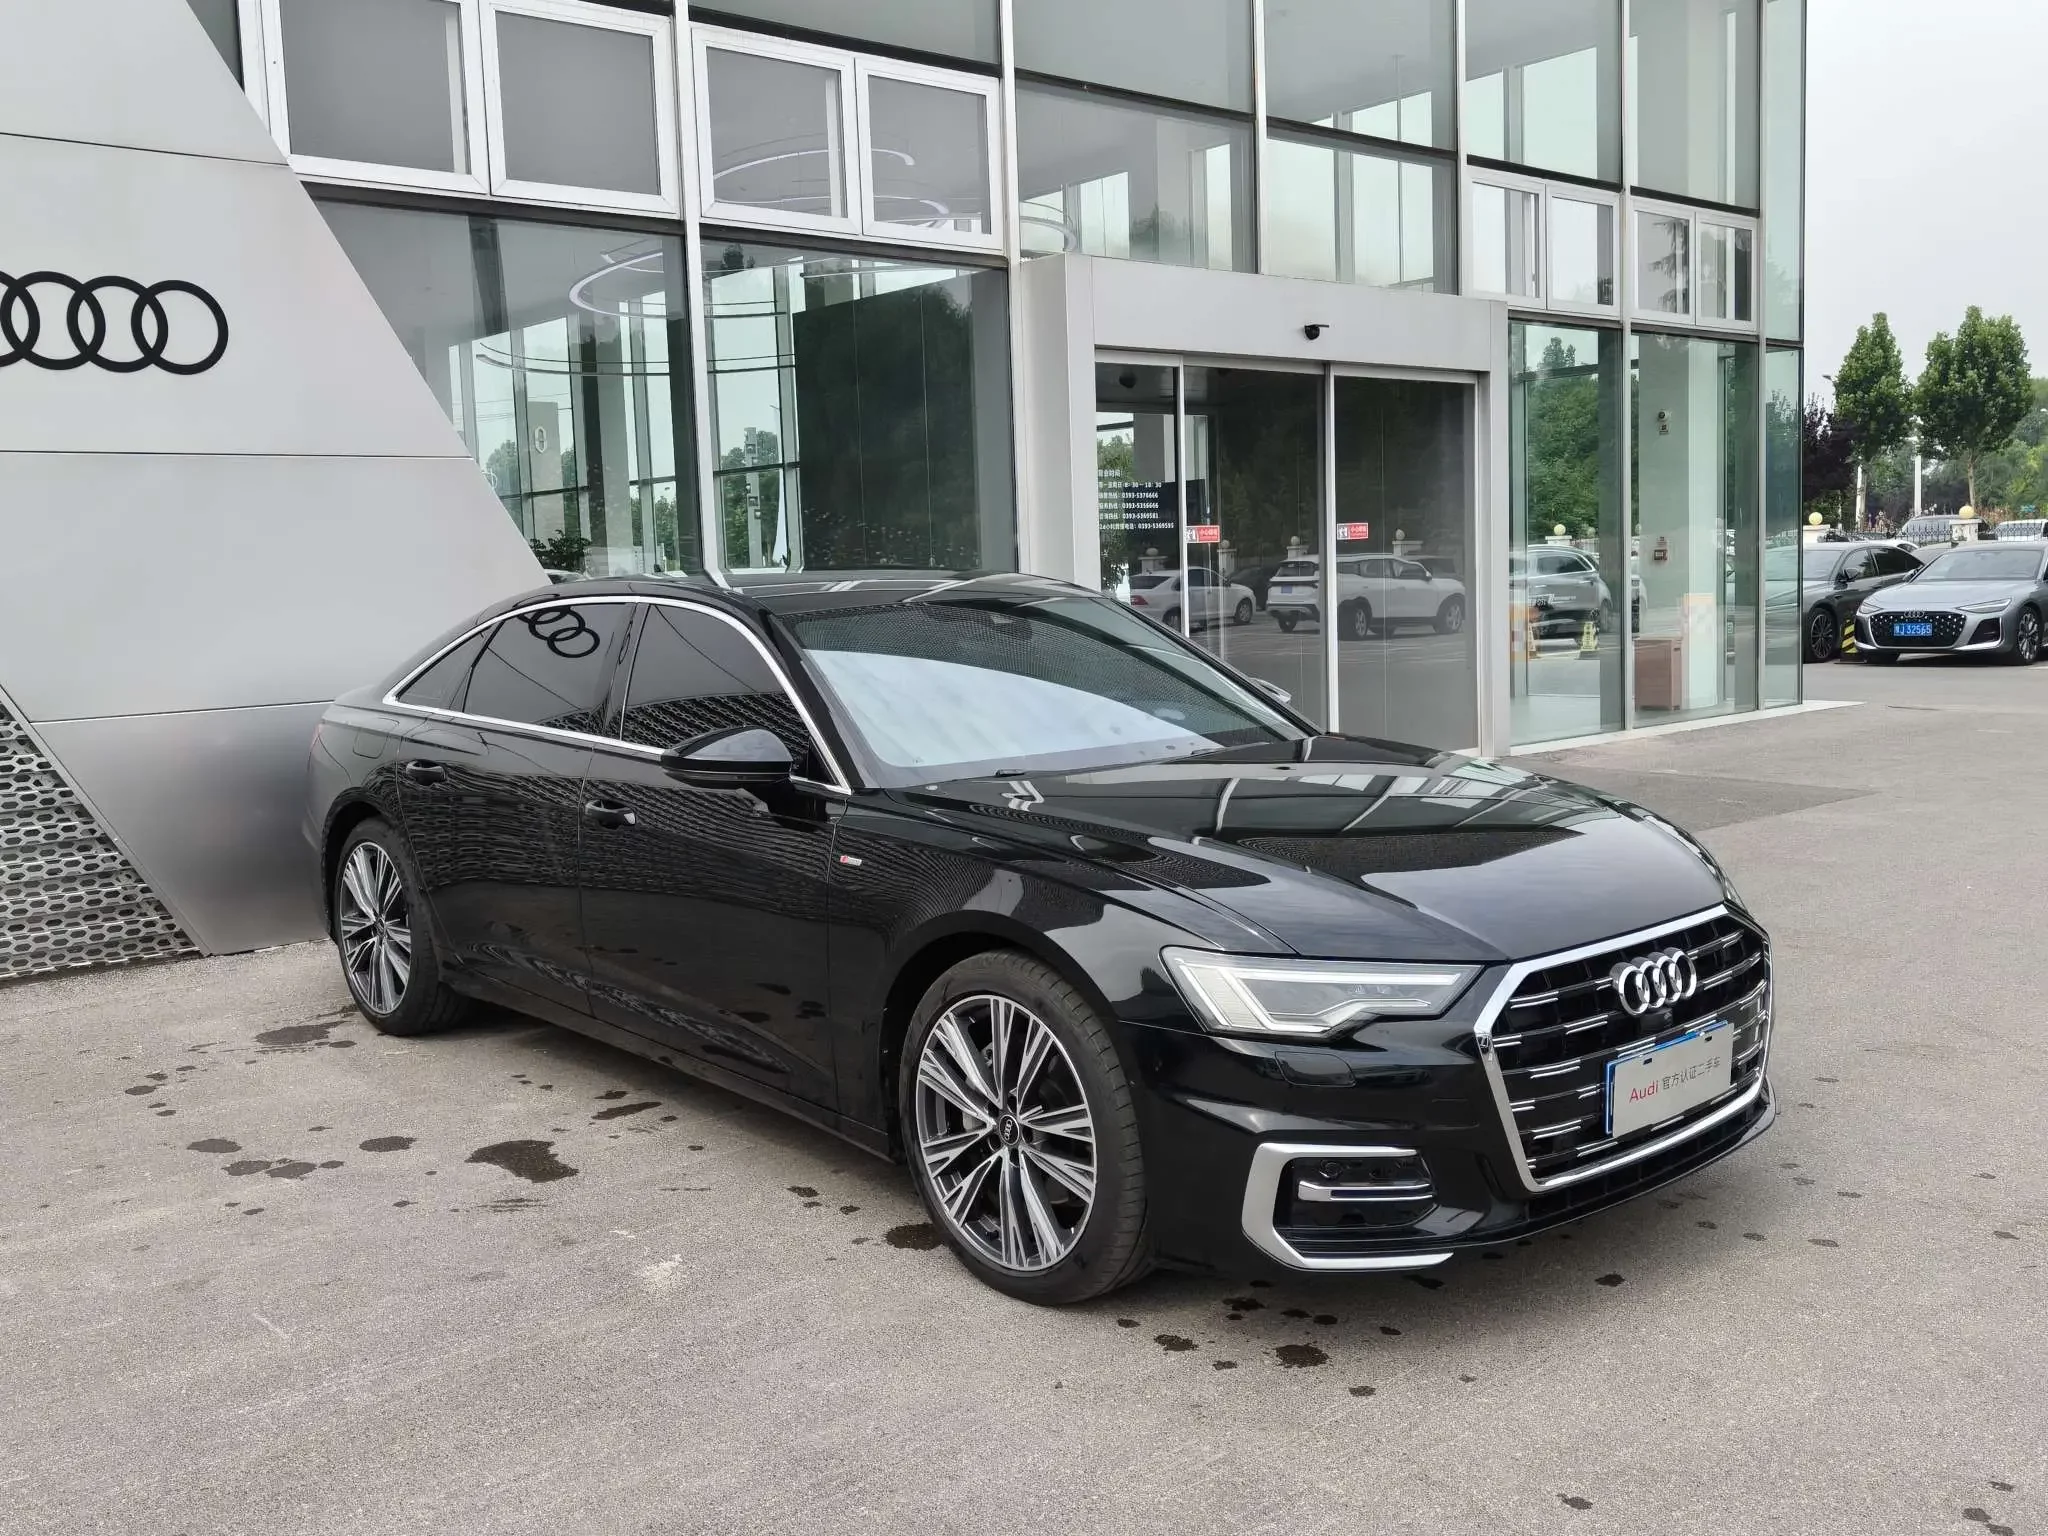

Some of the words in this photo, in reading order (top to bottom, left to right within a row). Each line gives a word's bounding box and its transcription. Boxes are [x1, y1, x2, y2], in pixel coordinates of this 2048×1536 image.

[1629, 1080, 1659, 1104] Audi
[1662, 1056, 1721, 1090] 官方认证二手车
